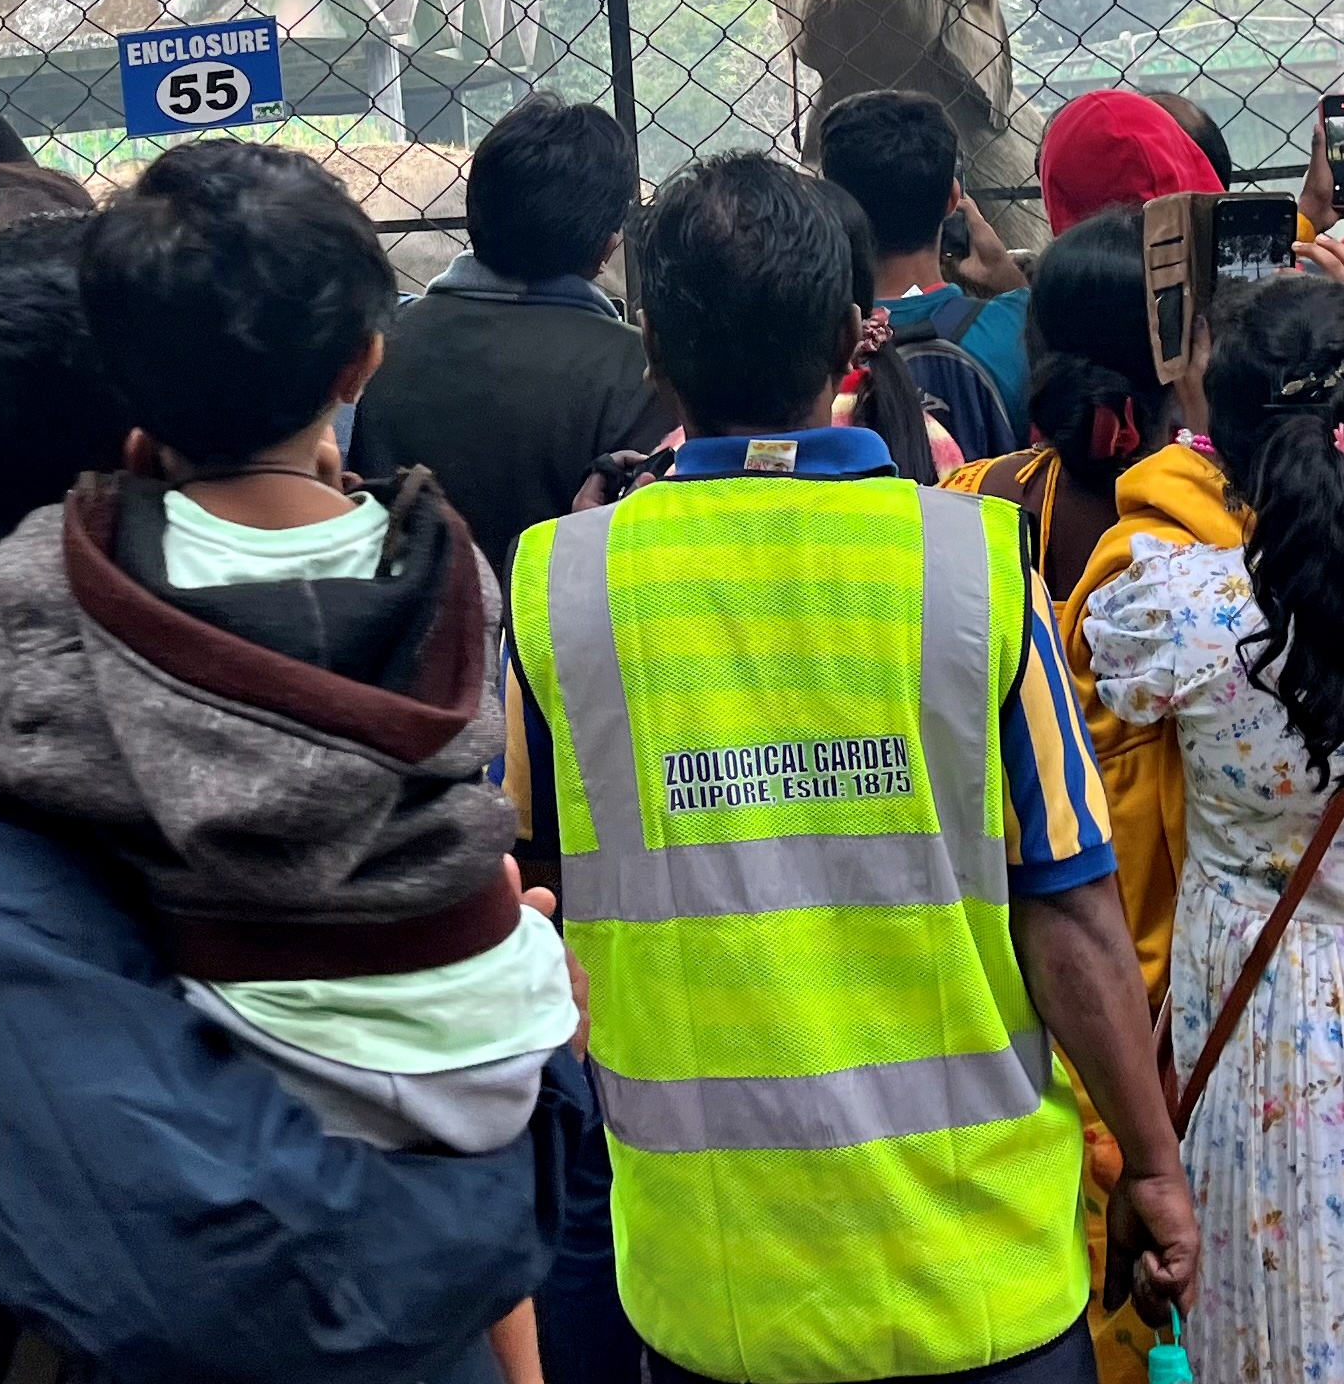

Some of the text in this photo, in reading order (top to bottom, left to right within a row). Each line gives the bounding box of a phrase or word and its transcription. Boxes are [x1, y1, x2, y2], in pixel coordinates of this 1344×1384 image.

[127, 27, 271, 66] ENCLOSURE
[168, 69, 239, 115] 55
[664, 737, 908, 786] ZOOLOGICAL GARDEN
[669, 770, 912, 813] ALIPORE, Estd: 1875
